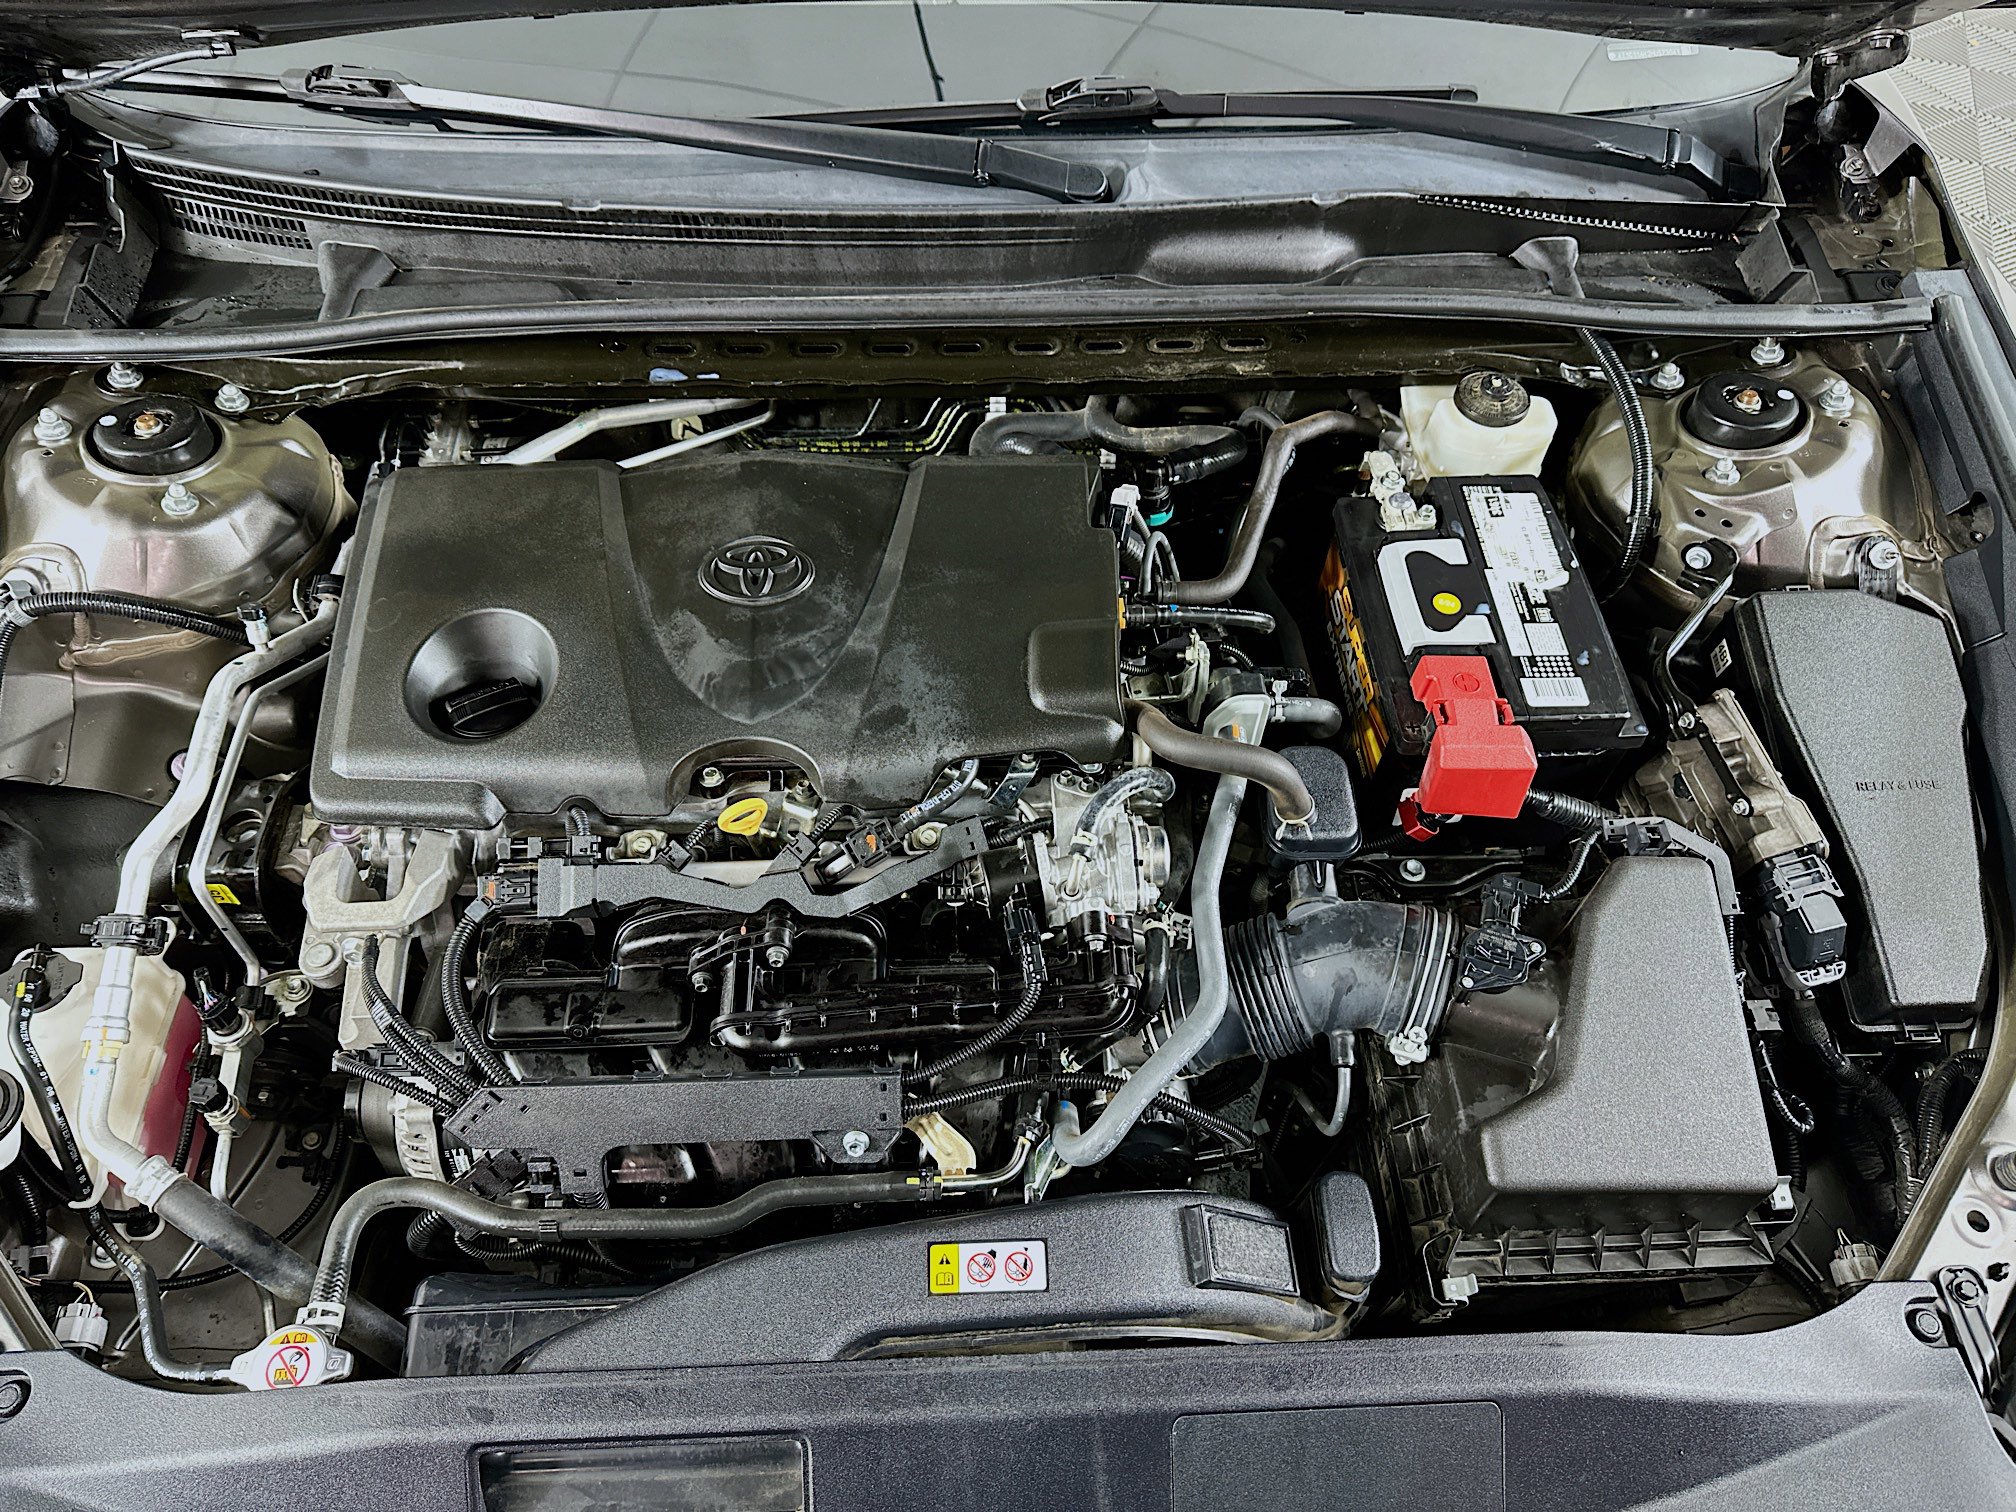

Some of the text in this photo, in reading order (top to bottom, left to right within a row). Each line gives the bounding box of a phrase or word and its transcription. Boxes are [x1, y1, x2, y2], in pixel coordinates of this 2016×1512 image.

[1330, 589, 1368, 713] START
[1340, 586, 1374, 705] SUPER
[1855, 780, 1895, 792] RELAY
[19, 1020, 30, 1043] WATER
[58, 1115, 71, 1141] WATER
